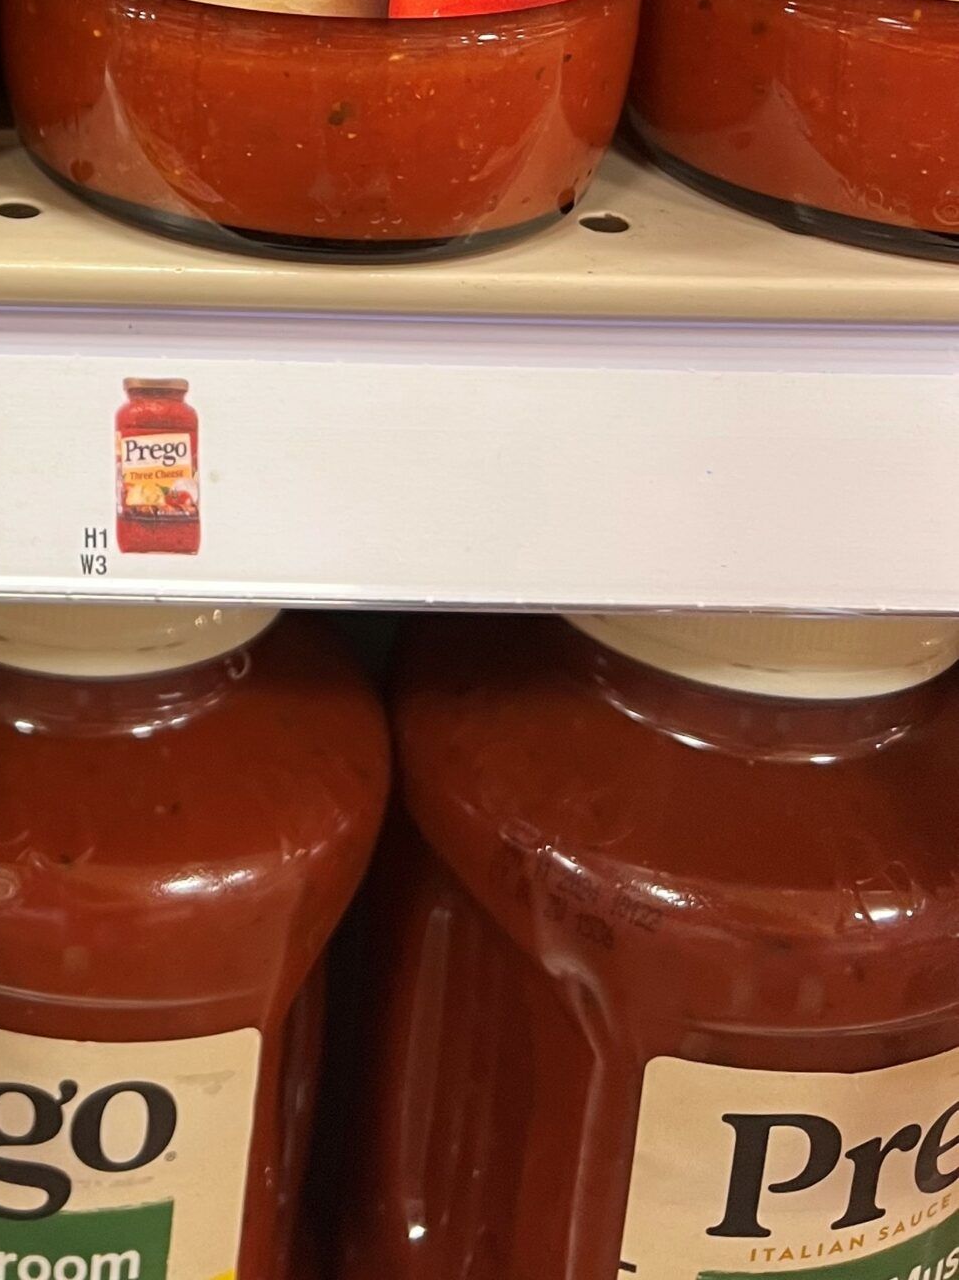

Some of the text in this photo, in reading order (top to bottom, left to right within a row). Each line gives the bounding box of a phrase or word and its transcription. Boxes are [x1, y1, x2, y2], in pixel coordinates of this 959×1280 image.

[125, 439, 187, 467] Prego
[84, 527, 107, 549] H1
[80, 554, 107, 576] W3
[749, 1193, 952, 1262] ITALIAN SAUCE
